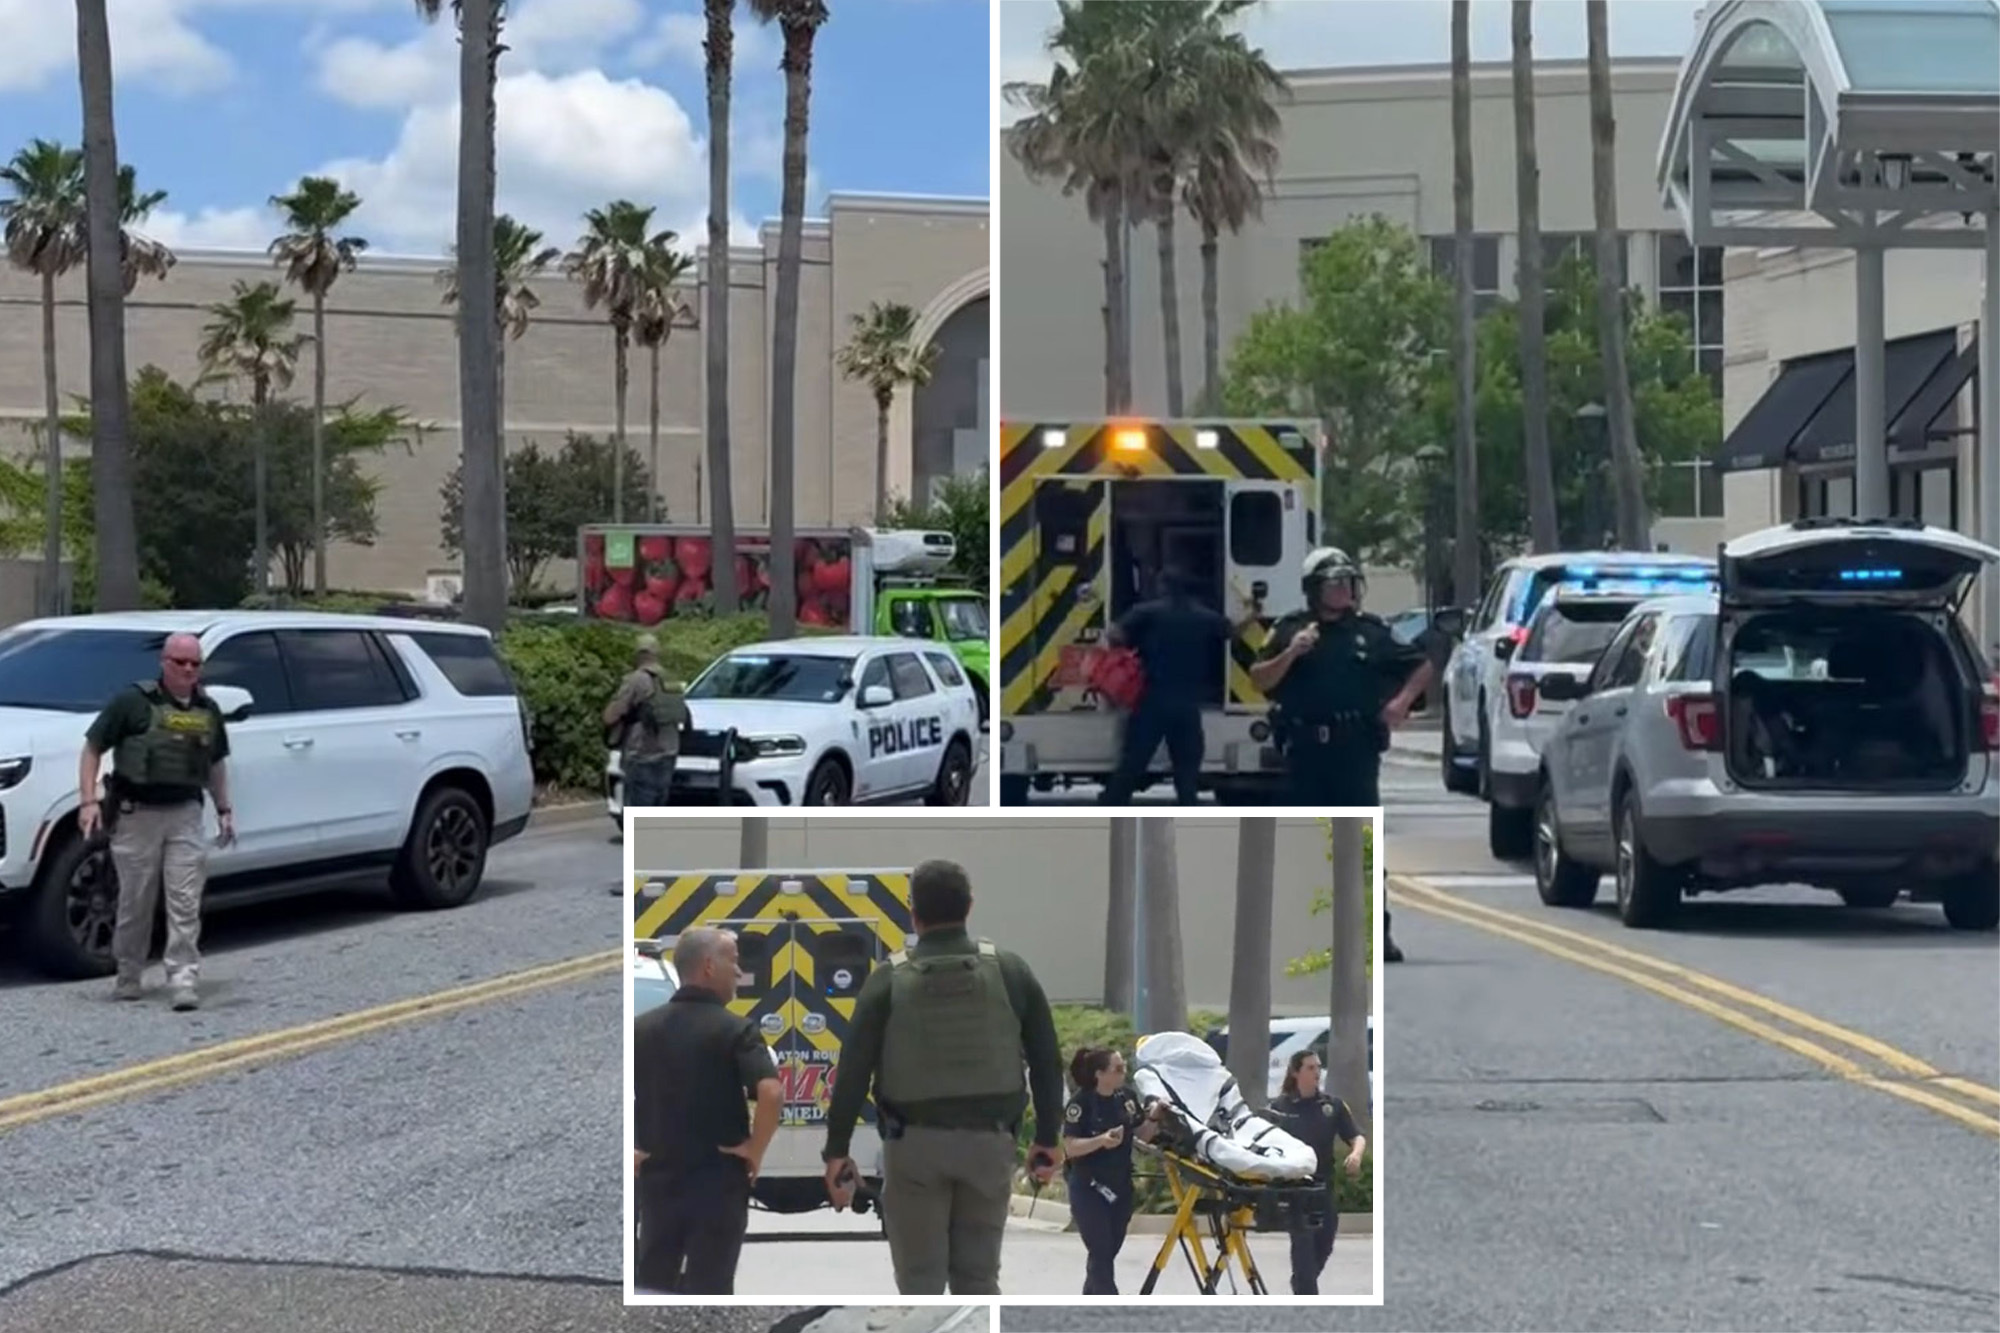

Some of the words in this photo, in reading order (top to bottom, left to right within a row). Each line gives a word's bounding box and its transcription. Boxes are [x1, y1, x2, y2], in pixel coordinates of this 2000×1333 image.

[868, 716, 942, 759] POLICE
[777, 1050, 810, 1061] ATON
[812, 1050, 840, 1061] ROU
[780, 1106, 829, 1120] MED
